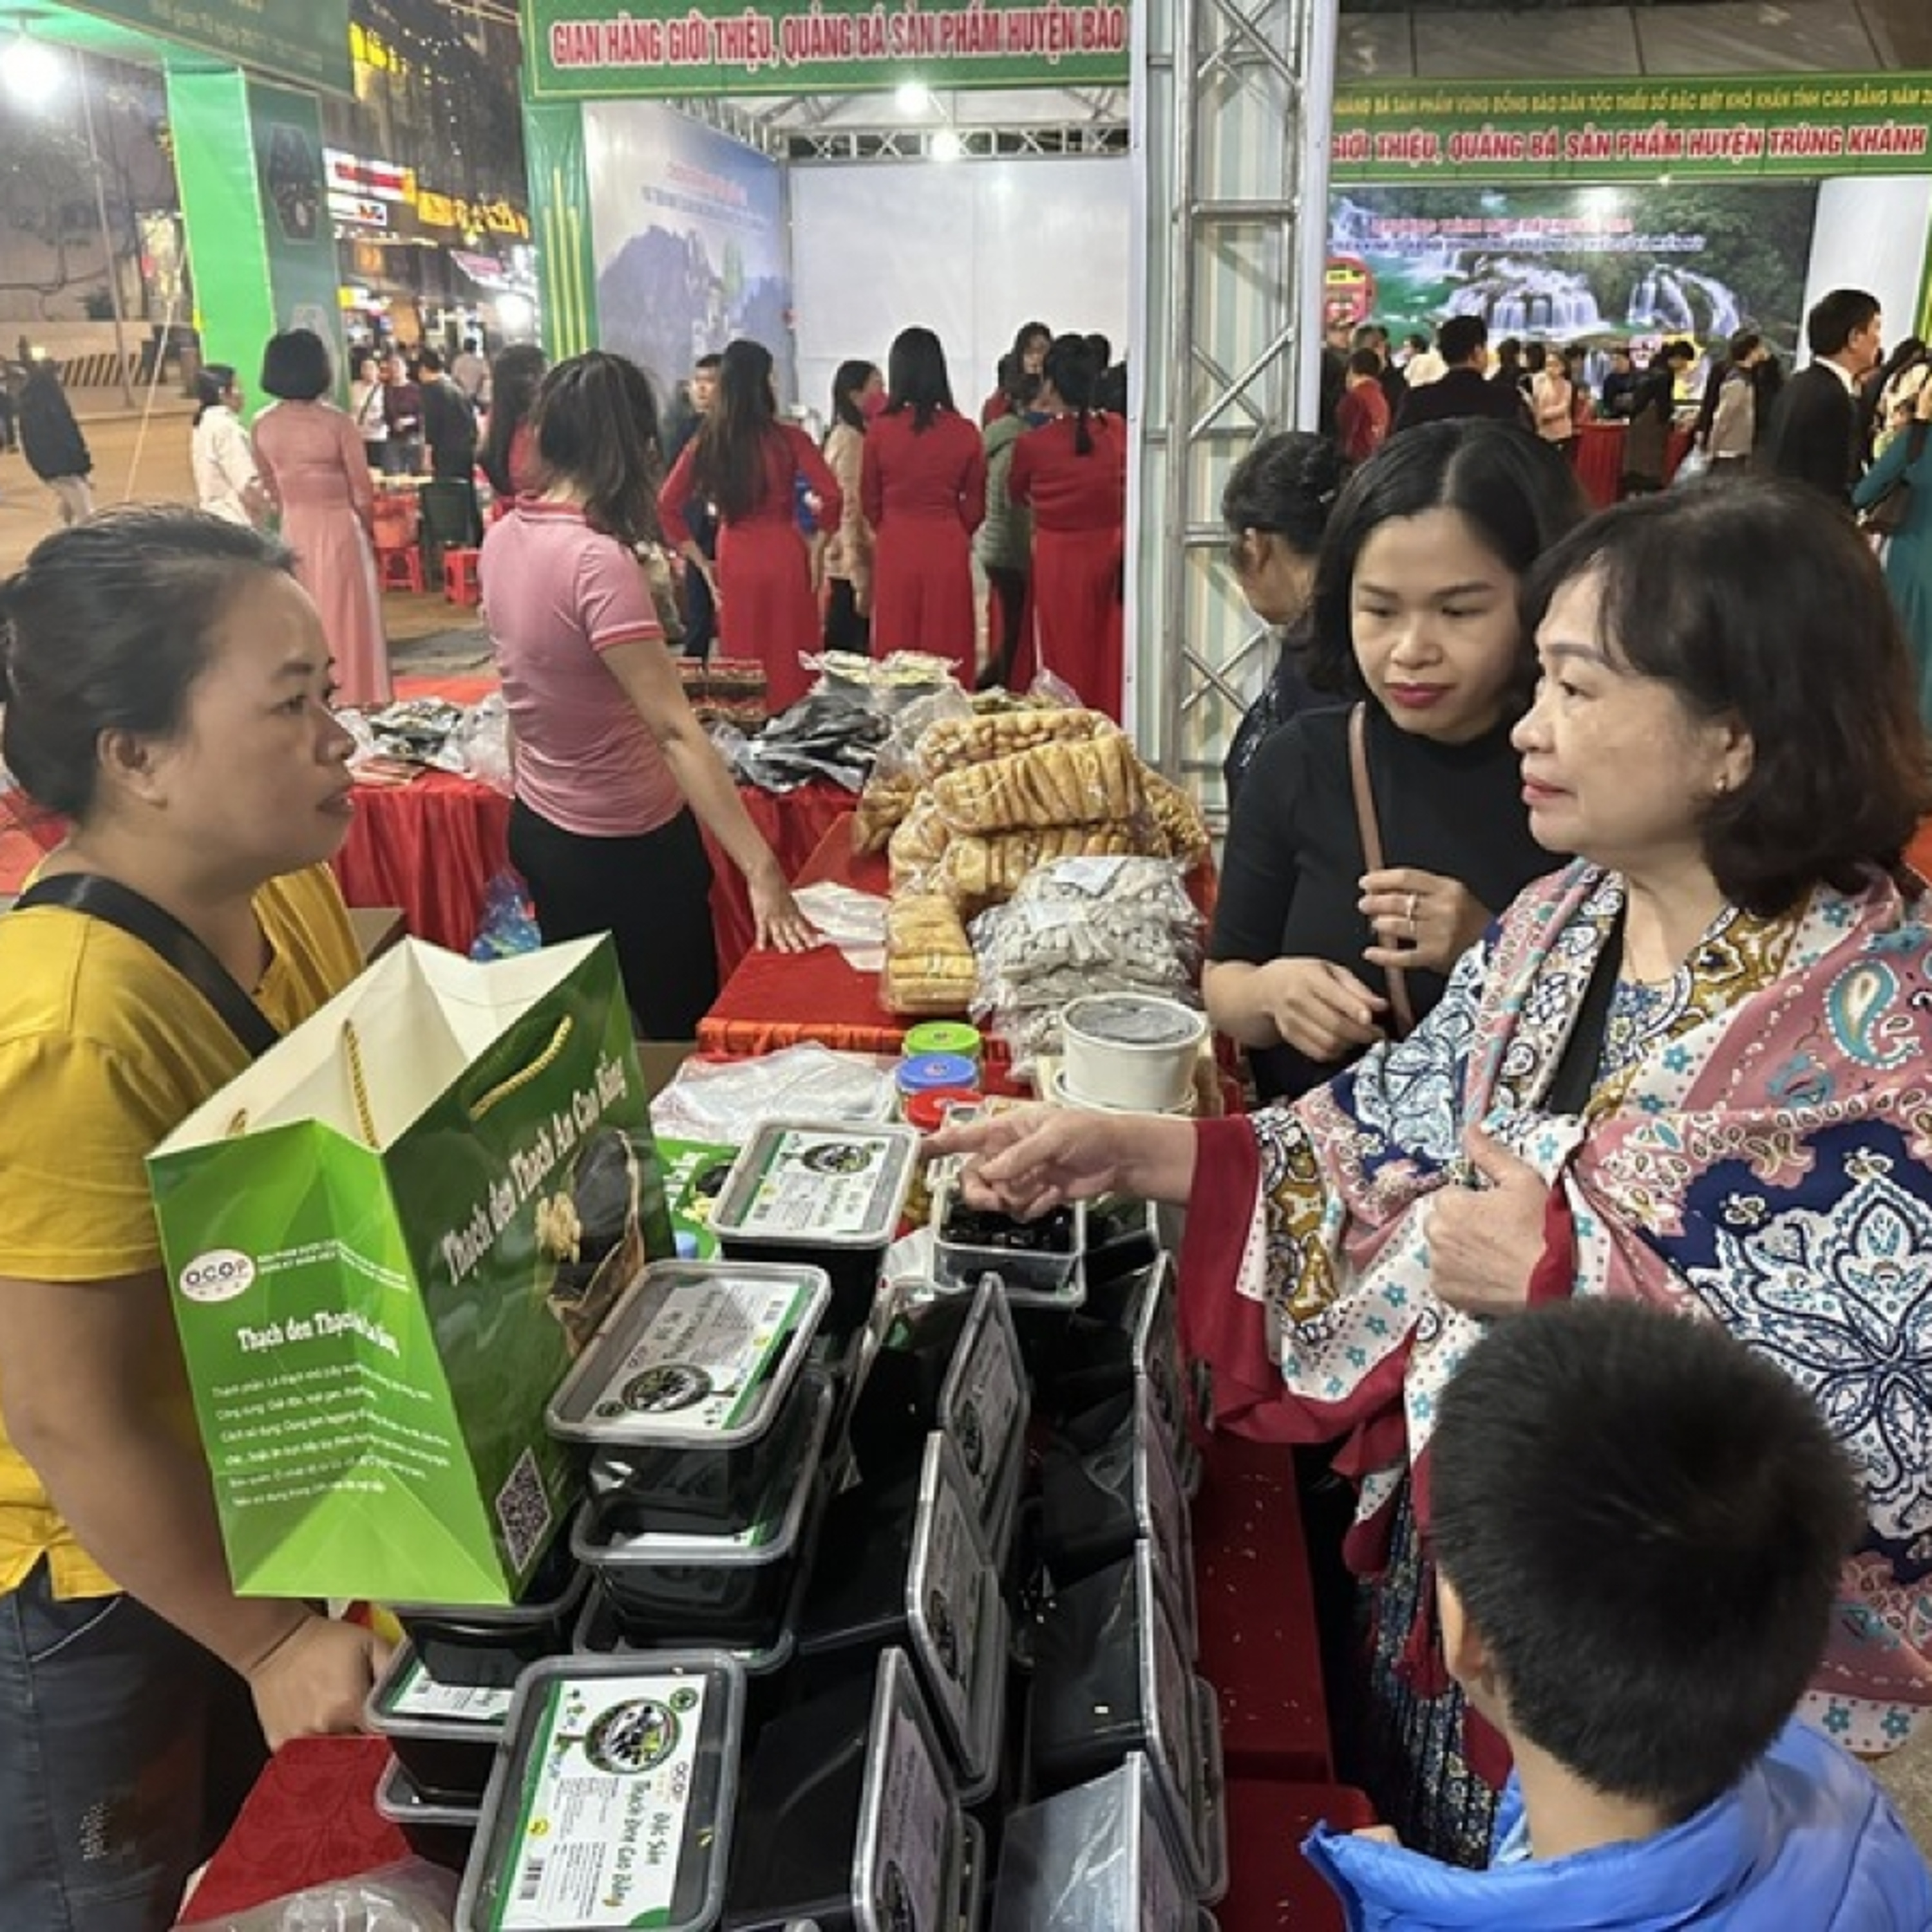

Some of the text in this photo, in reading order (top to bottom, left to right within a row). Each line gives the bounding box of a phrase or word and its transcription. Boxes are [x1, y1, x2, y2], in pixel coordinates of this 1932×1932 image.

[552, 22, 602, 66] GIAN
[605, 10, 663, 66] HÀNG
[667, 8, 709, 65] GIỚI
[714, 6, 779, 72] THIỆU,
[782, 1, 852, 67] QUẢNG
[857, 3, 887, 59] BÁ
[891, 0, 935, 57] SẢN
[940, 0, 1000, 56] PHẨM
[1005, 0, 1076, 64] HUYỆN
[1376, 128, 1443, 168] THIỆU,
[1449, 122, 1525, 165] QUẢNG
[1528, 126, 1559, 162] BÁ
[1565, 122, 1613, 161] SẢN
[1616, 119, 1684, 161] PHẨM
[1687, 120, 1765, 164] HUYỆN
[1769, 121, 1843, 158] TRÙNG
[1846, 119, 1927, 155] KHÁNH
[186, 1260, 249, 1285] OCOP
[238, 1323, 283, 1353] Thạch
